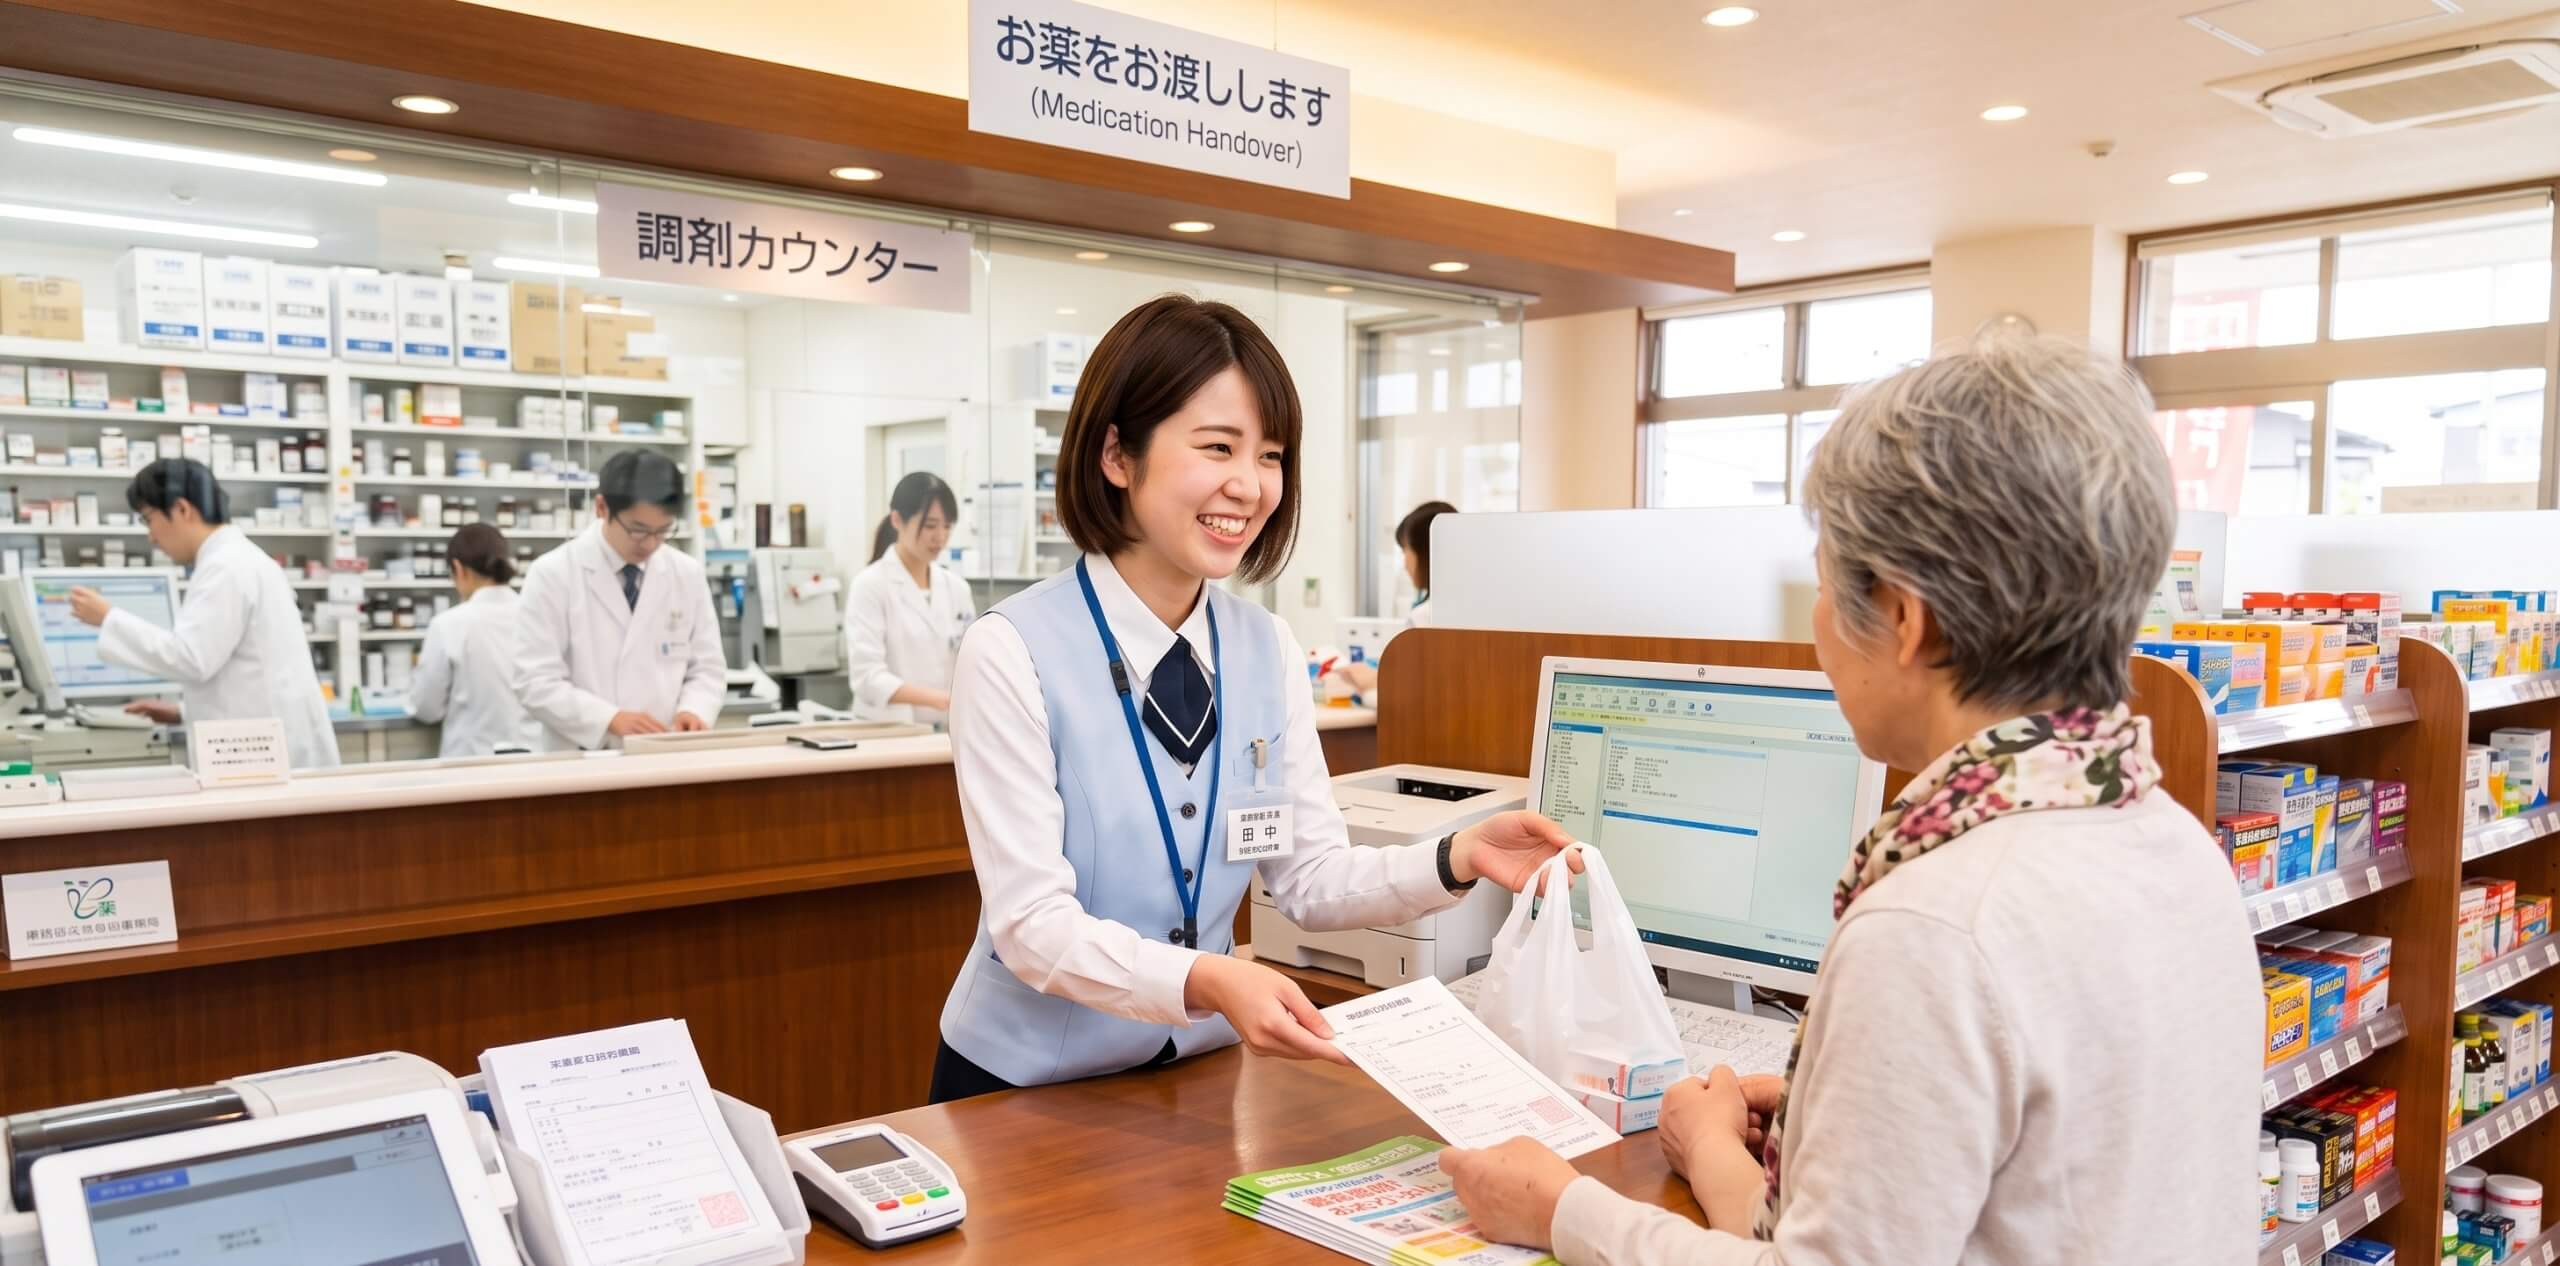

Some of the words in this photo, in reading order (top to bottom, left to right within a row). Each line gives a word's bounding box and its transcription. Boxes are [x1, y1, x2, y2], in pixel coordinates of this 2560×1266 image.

[995, 15, 1331, 128] お薬をお渡しします
[1031, 86, 1178, 142] (Medication
[1188, 119, 1303, 169] Handover)
[636, 209, 939, 284] 調剤カウンター
